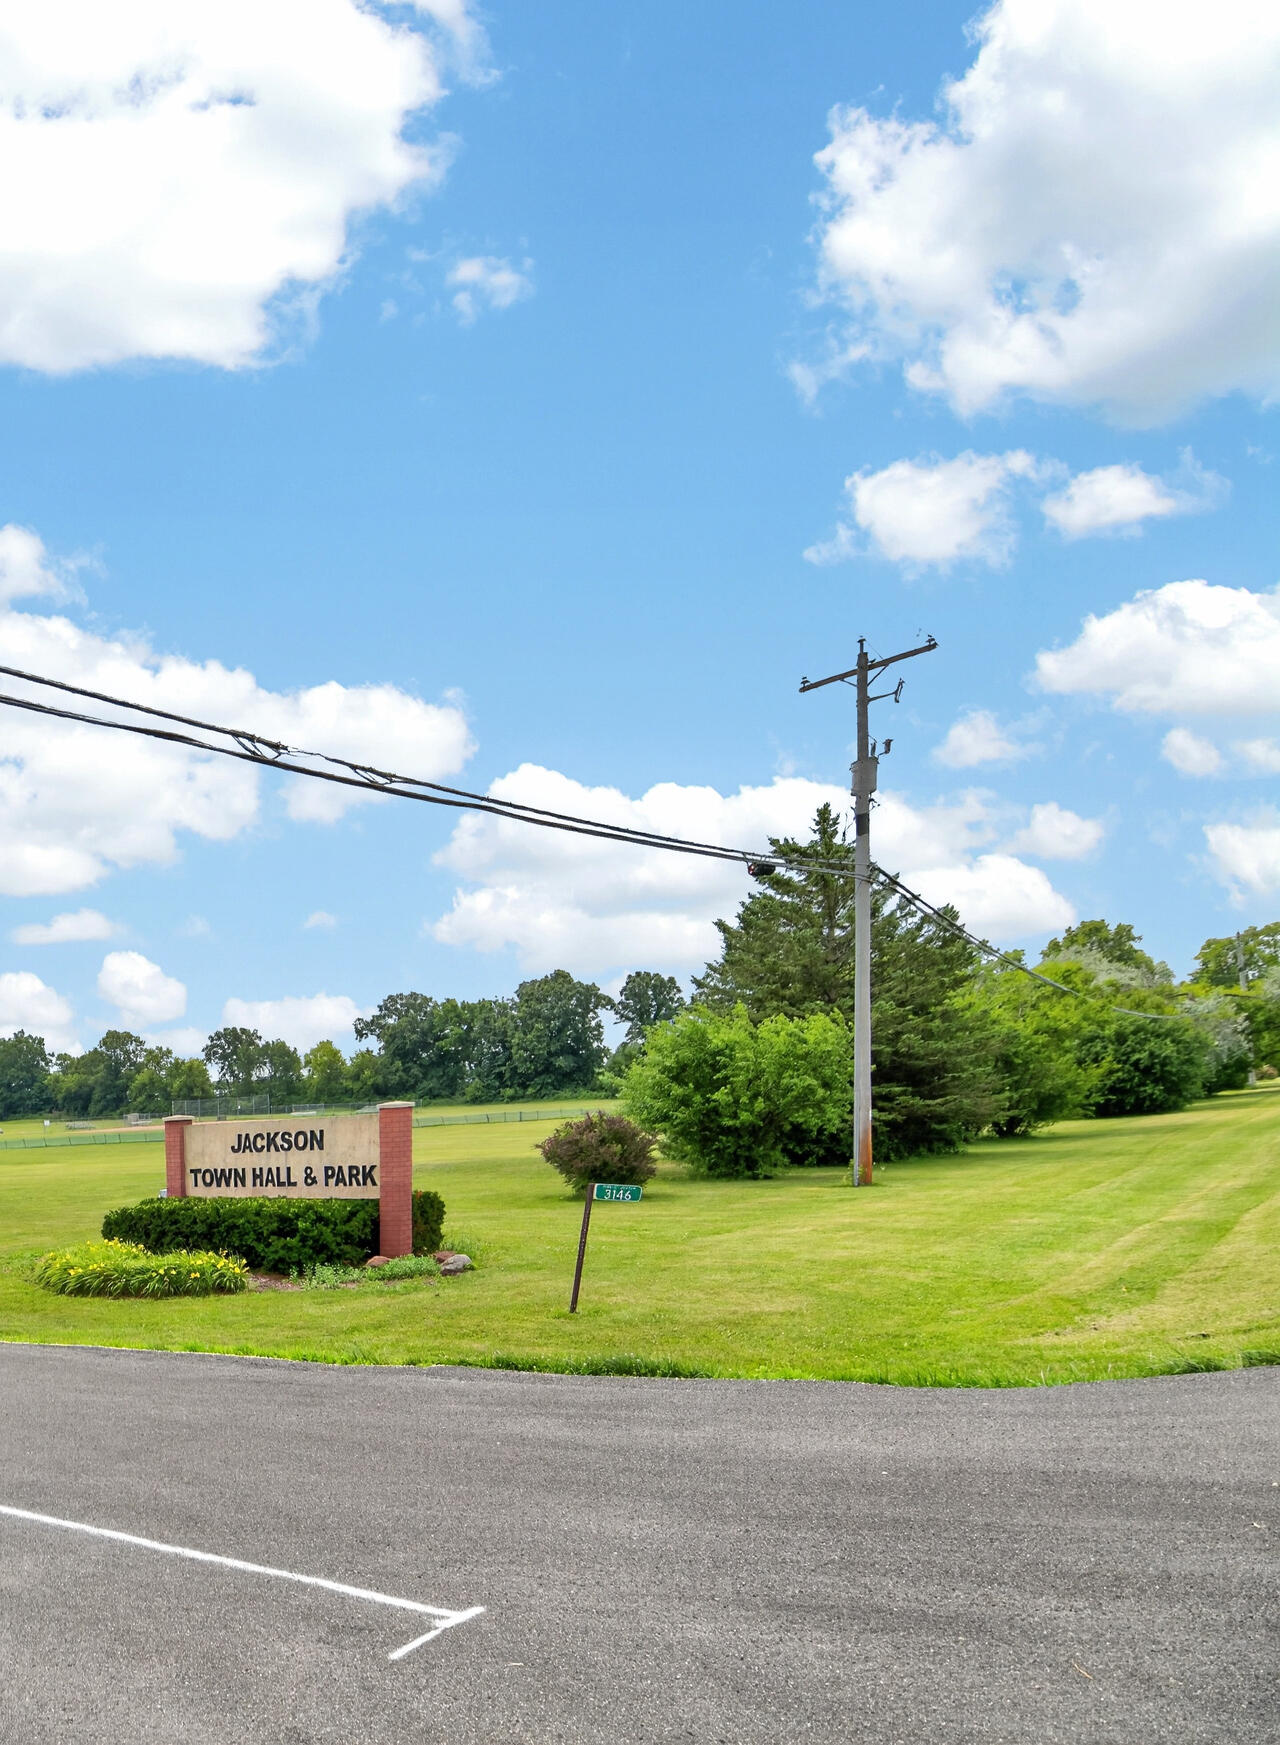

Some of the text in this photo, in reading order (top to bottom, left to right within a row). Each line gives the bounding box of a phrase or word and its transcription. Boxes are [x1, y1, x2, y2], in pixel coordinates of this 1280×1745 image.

[230, 1129, 325, 1154] JACKSON
[189, 1164, 378, 1188] TOWN HALL & PARK
[604, 1189, 632, 1201] 3146
